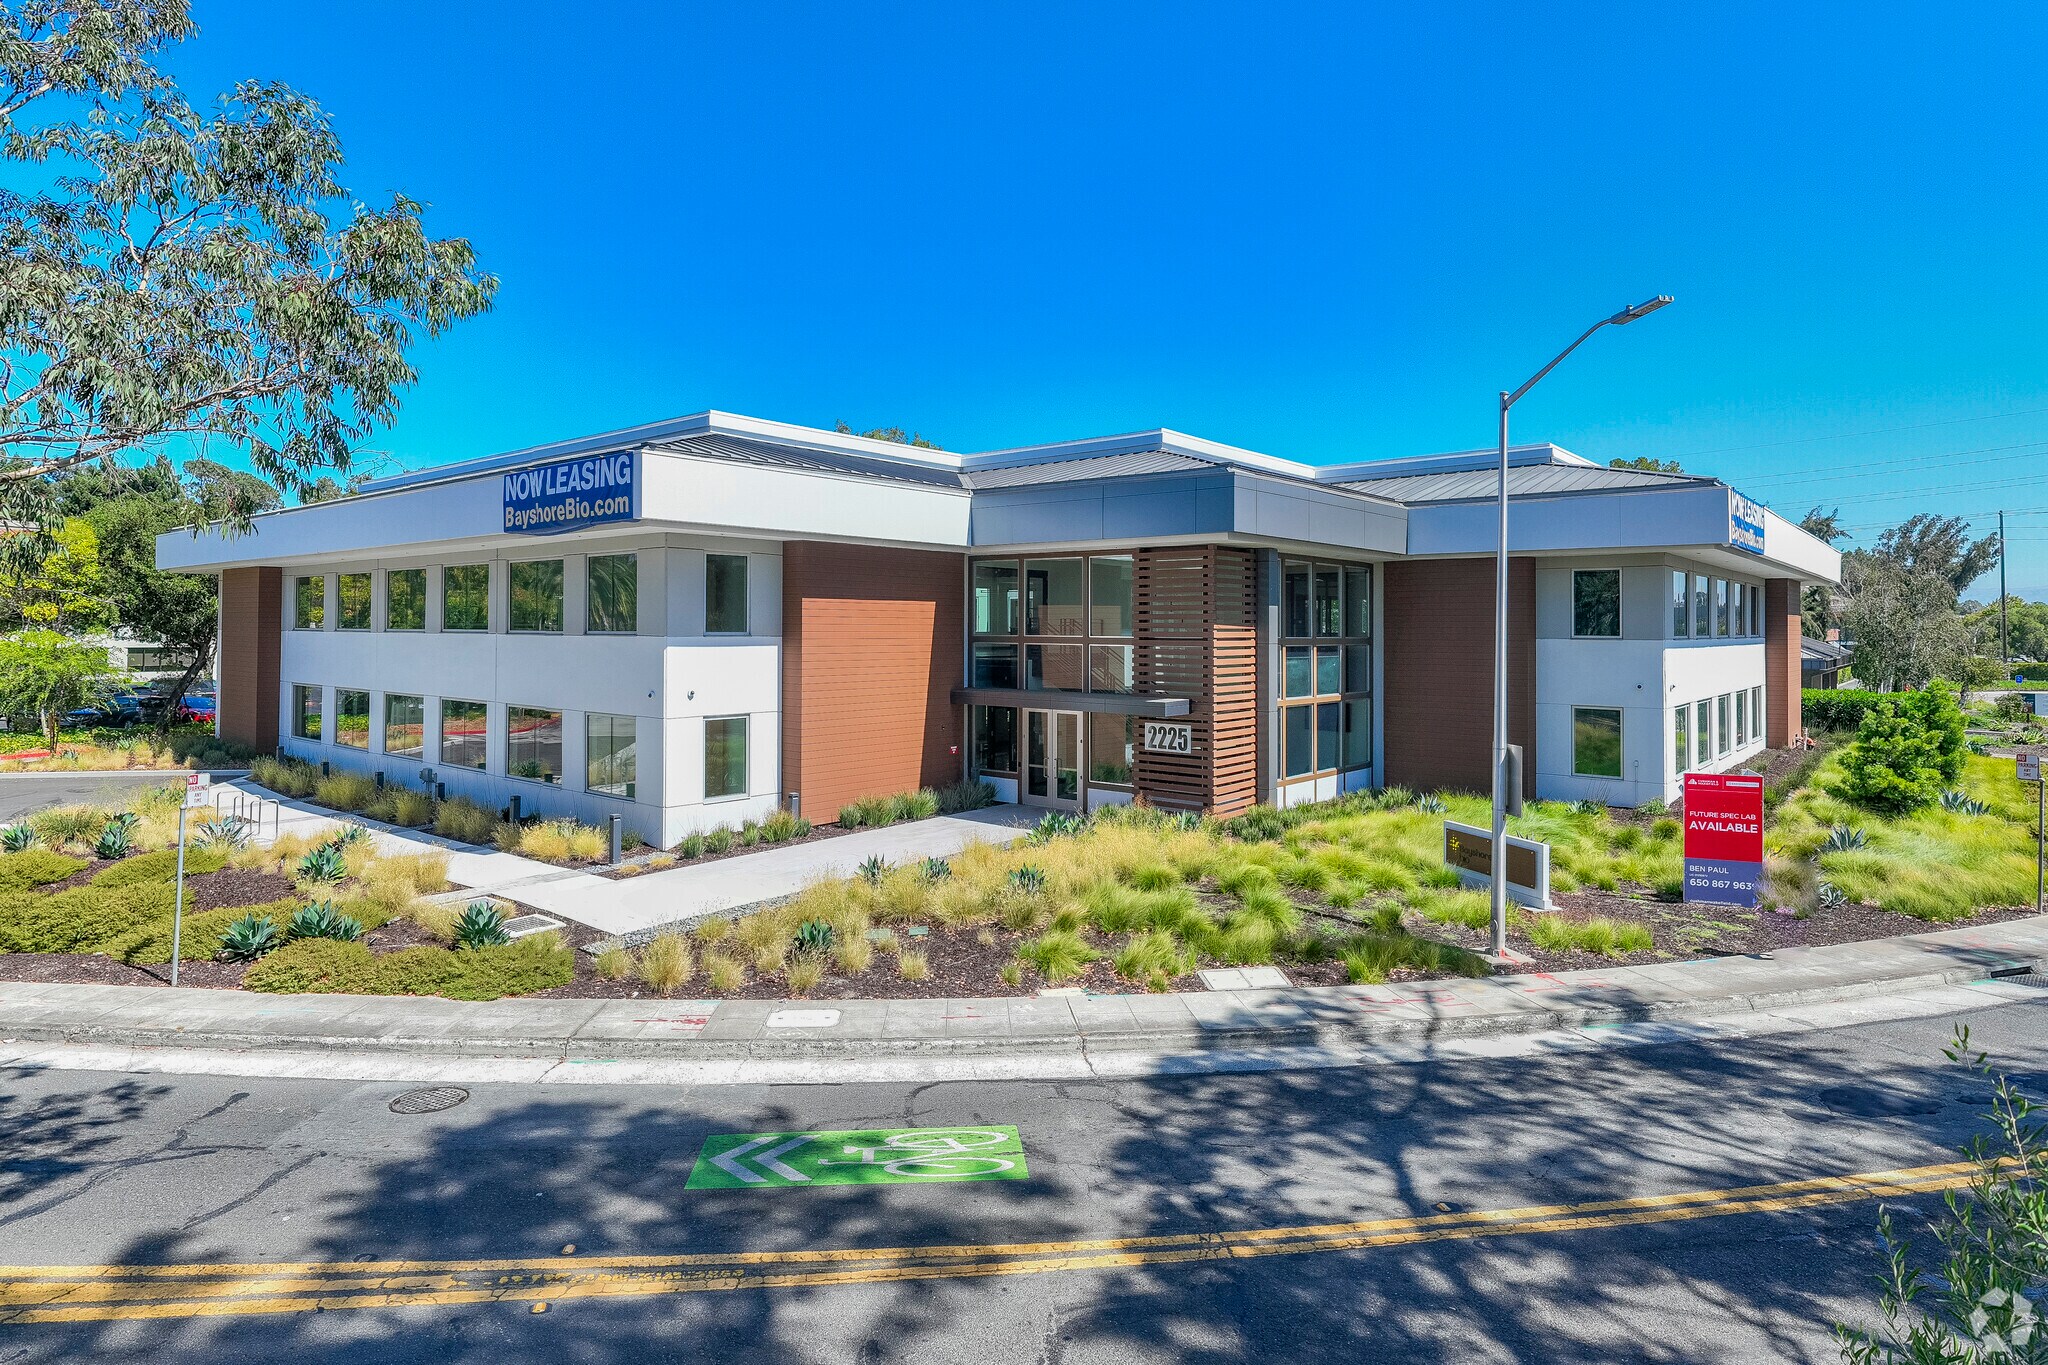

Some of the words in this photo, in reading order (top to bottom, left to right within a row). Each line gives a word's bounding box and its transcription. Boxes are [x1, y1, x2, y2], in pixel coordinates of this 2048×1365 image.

[505, 469, 545, 502] NOW
[546, 454, 631, 496] LEASING
[505, 495, 630, 530] BayshoreBio.com
[1147, 725, 1188, 752] 2225
[2017, 754, 2026, 762] NO
[188, 775, 198, 784] NO
[1689, 810, 1718, 819] FUTURE
[1720, 812, 1740, 820] SPEC
[1740, 813, 1757, 821] LAB
[1689, 820, 1759, 834] AVAILABLE
[1689, 864, 1706, 872] BEN
[1707, 866, 1729, 875] PAUL
[1689, 878, 1710, 887] 650
[1711, 880, 1731, 889] 867
